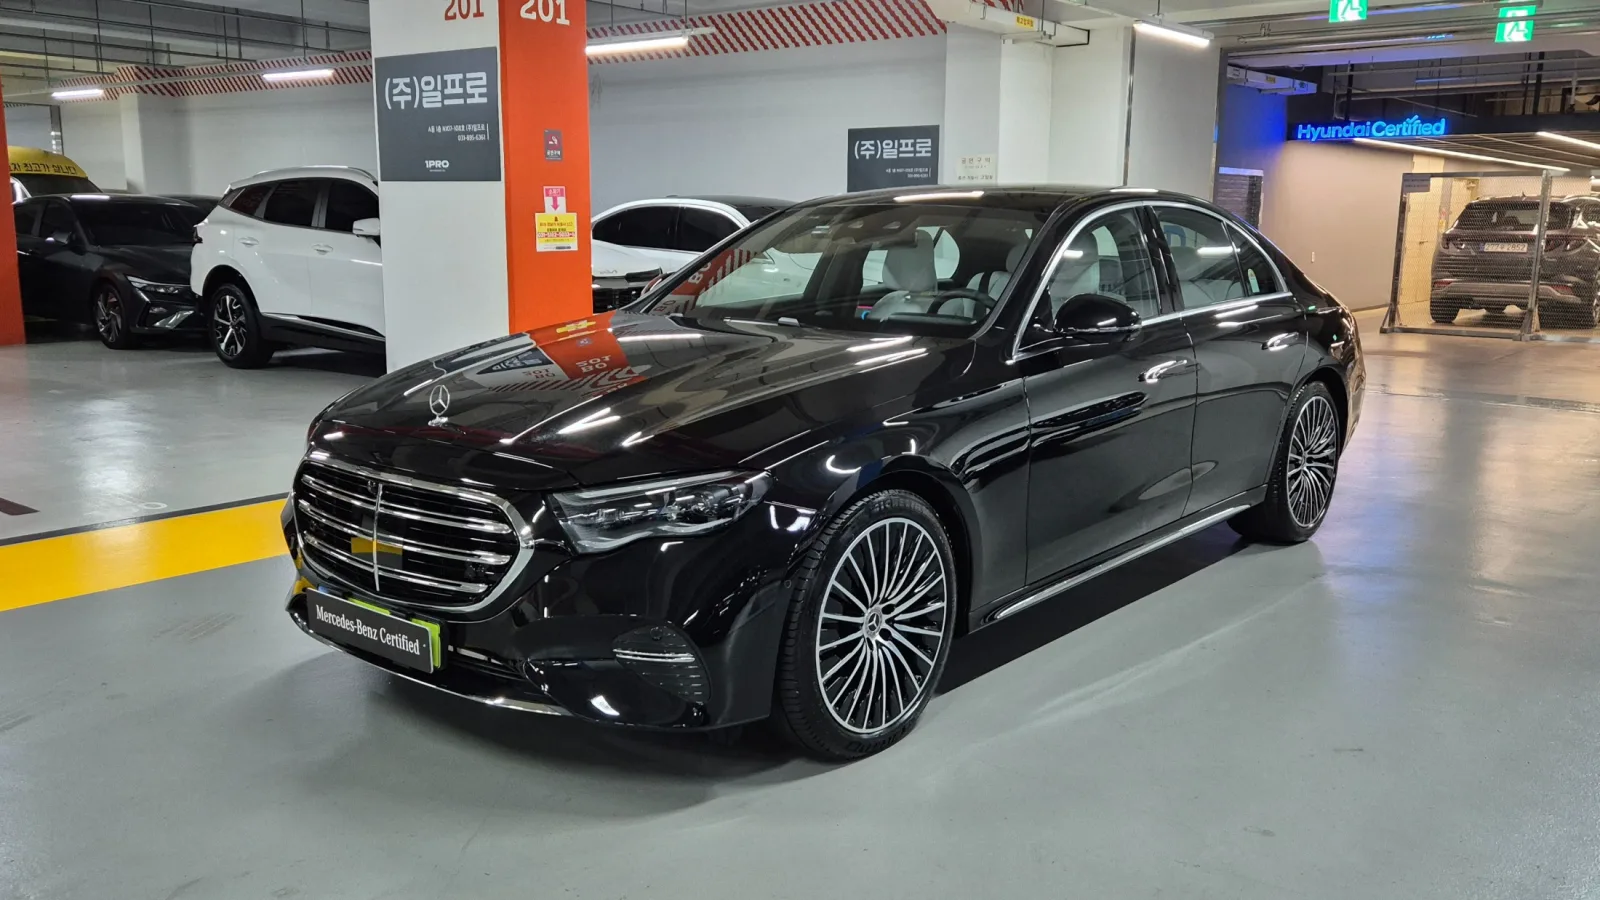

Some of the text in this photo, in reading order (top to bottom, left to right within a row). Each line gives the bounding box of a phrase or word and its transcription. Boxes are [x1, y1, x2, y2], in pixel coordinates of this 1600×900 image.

[444, 0, 484, 20] 201
[520, 0, 570, 25] 201
[385, 72, 488, 110] (주)일프로
[1298, 115, 1446, 142] Hyundai Certified
[854, 138, 932, 159] (주)일프로
[425, 160, 449, 168] 1PRO
[316, 604, 420, 655] Mercedes-Benz Certified
